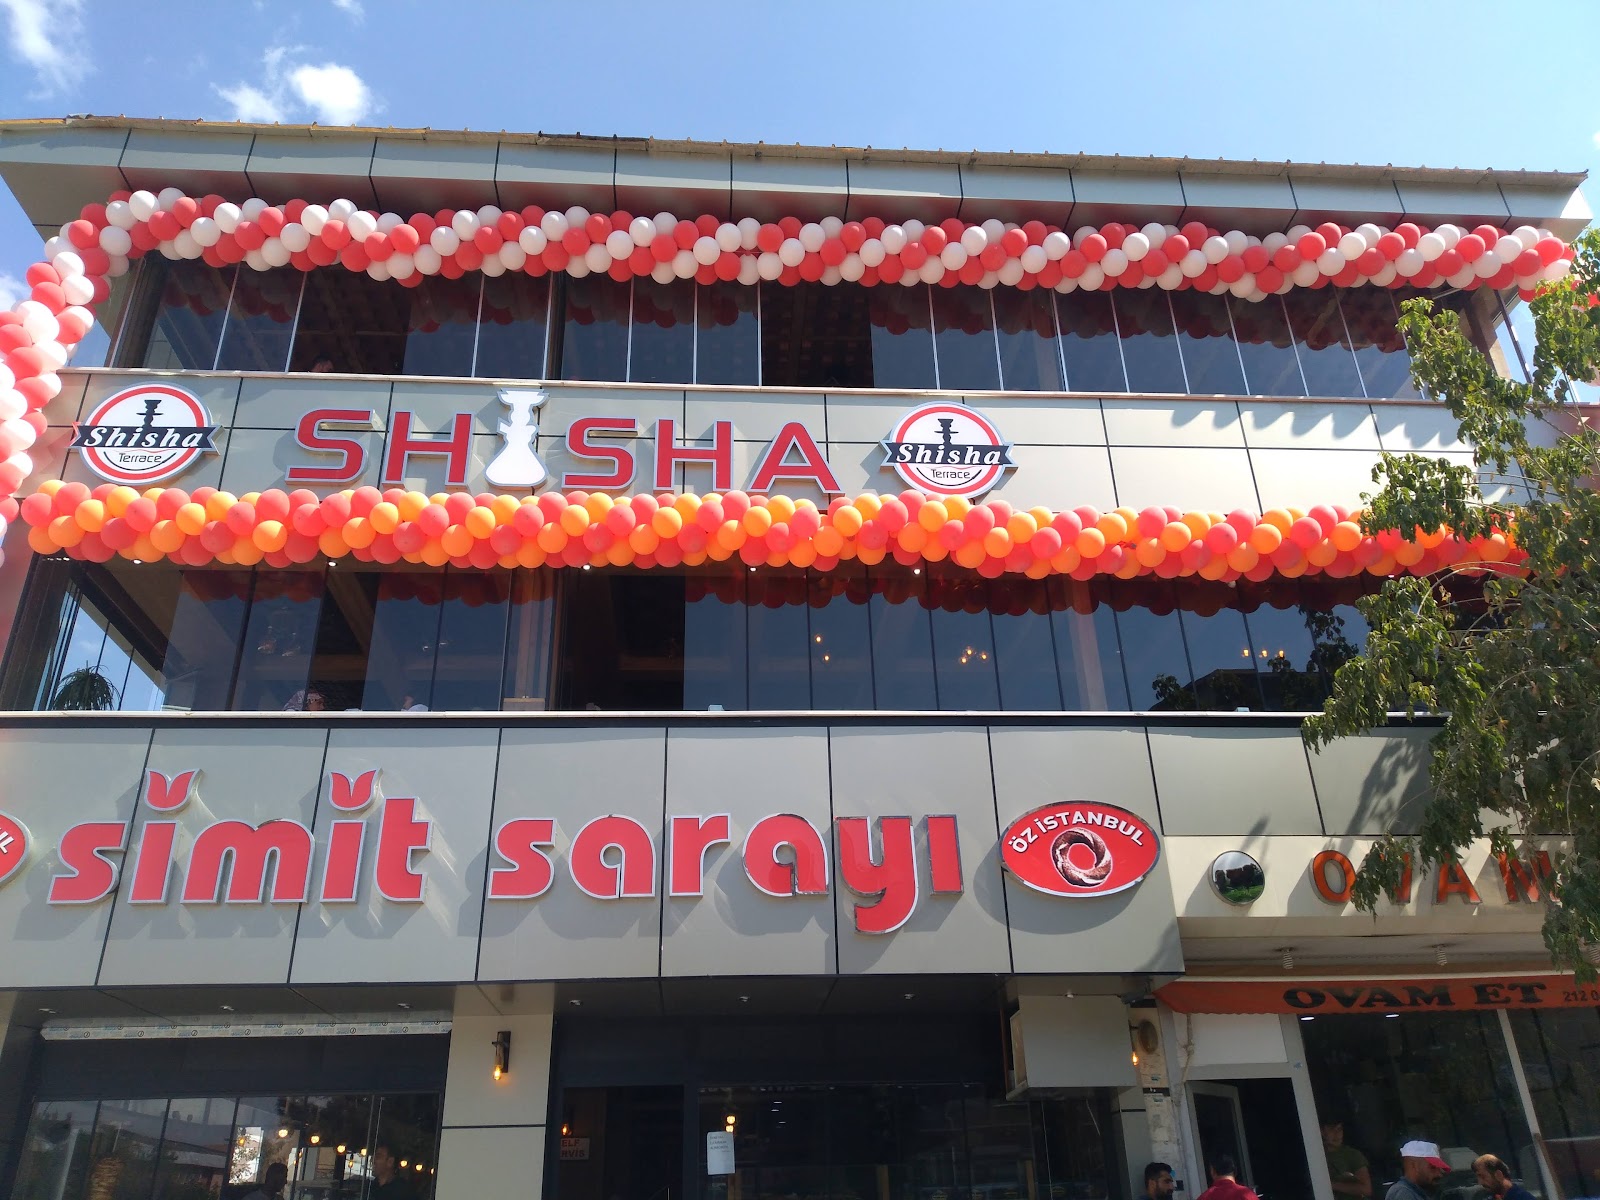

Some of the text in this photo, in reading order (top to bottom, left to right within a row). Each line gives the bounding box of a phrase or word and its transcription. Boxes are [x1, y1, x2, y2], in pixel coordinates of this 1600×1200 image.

[84, 426, 203, 448] Shisha
[118, 452, 162, 464] Terrace
[896, 443, 1001, 465] Shisha
[930, 468, 971, 480] Terrace
[47, 767, 433, 904] simit
[1008, 810, 1144, 854] ÖZ İSTANBUL
[1282, 985, 1456, 1009] OVAM
[1471, 982, 1548, 1006] ET
[561, 1139, 580, 1147] ELF
